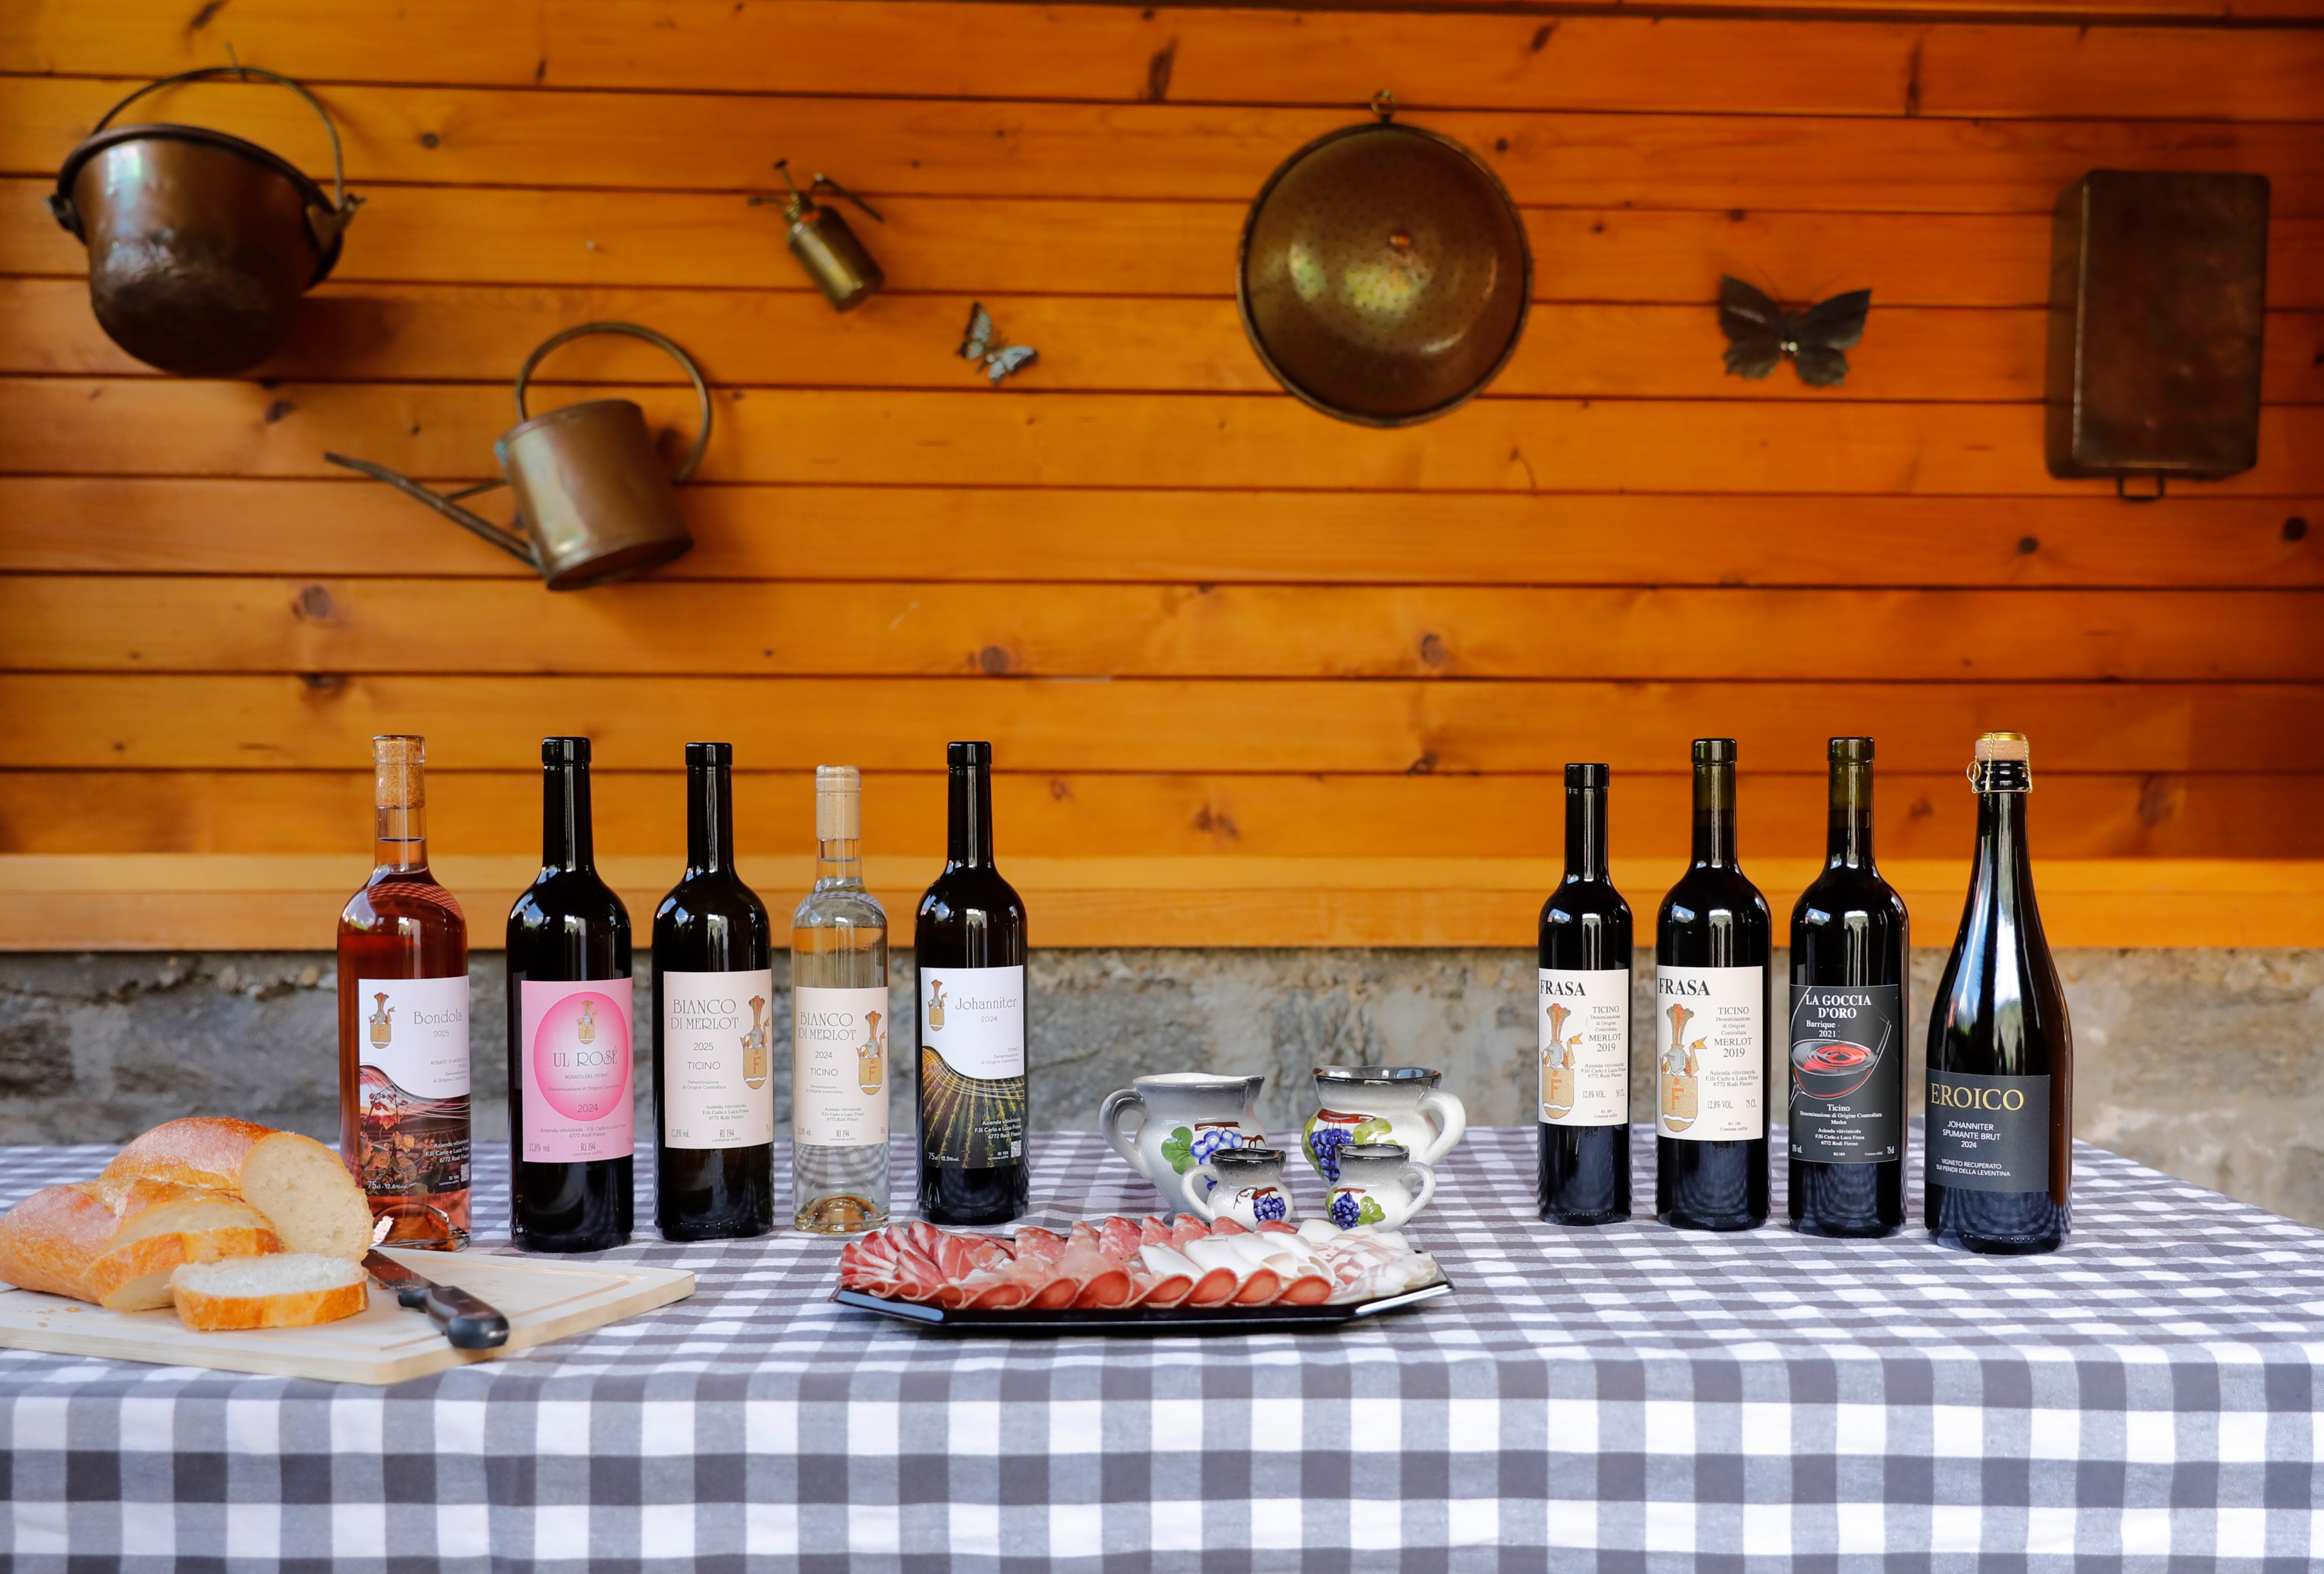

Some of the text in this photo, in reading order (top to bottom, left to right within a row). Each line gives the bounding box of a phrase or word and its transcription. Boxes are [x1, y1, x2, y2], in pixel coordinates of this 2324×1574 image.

[1540, 979, 1586, 996] FRASA
[1659, 978, 1710, 996] FRASA
[955, 997, 1016, 1010] Johanniter
[1806, 995, 1871, 1005] LA GOCCIA
[673, 999, 736, 1014] BIANCO
[1718, 1007, 1749, 1015] TICINO
[413, 1008, 462, 1024] Bondola
[1818, 1007, 1857, 1018] D'ORO
[671, 1017, 738, 1029] DI MERLOT
[800, 1012, 853, 1026] BIANCO
[1806, 1020, 1836, 1029] Barrique
[799, 1028, 856, 1040] DI MERLOT
[693, 1042, 713, 1051] 2025
[1714, 1037, 1752, 1046] MERLOT
[1597, 1043, 1616, 1052] 2019
[1723, 1048, 1745, 1057] 2019
[553, 1046, 617, 1067] UL ROSÉ
[1583, 1090, 1594, 1099] 12,8%
[1931, 1082, 2024, 1110] EROICO
[577, 1104, 598, 1113] 2024
[1708, 1100, 1733, 1110] 12,8% VOL.
[1947, 1121, 1994, 1131] JOHANNITER
[720, 1129, 725, 1137] RI
[1942, 1128, 1979, 1139] SPUMANTE
[581, 1143, 586, 1151] RI
